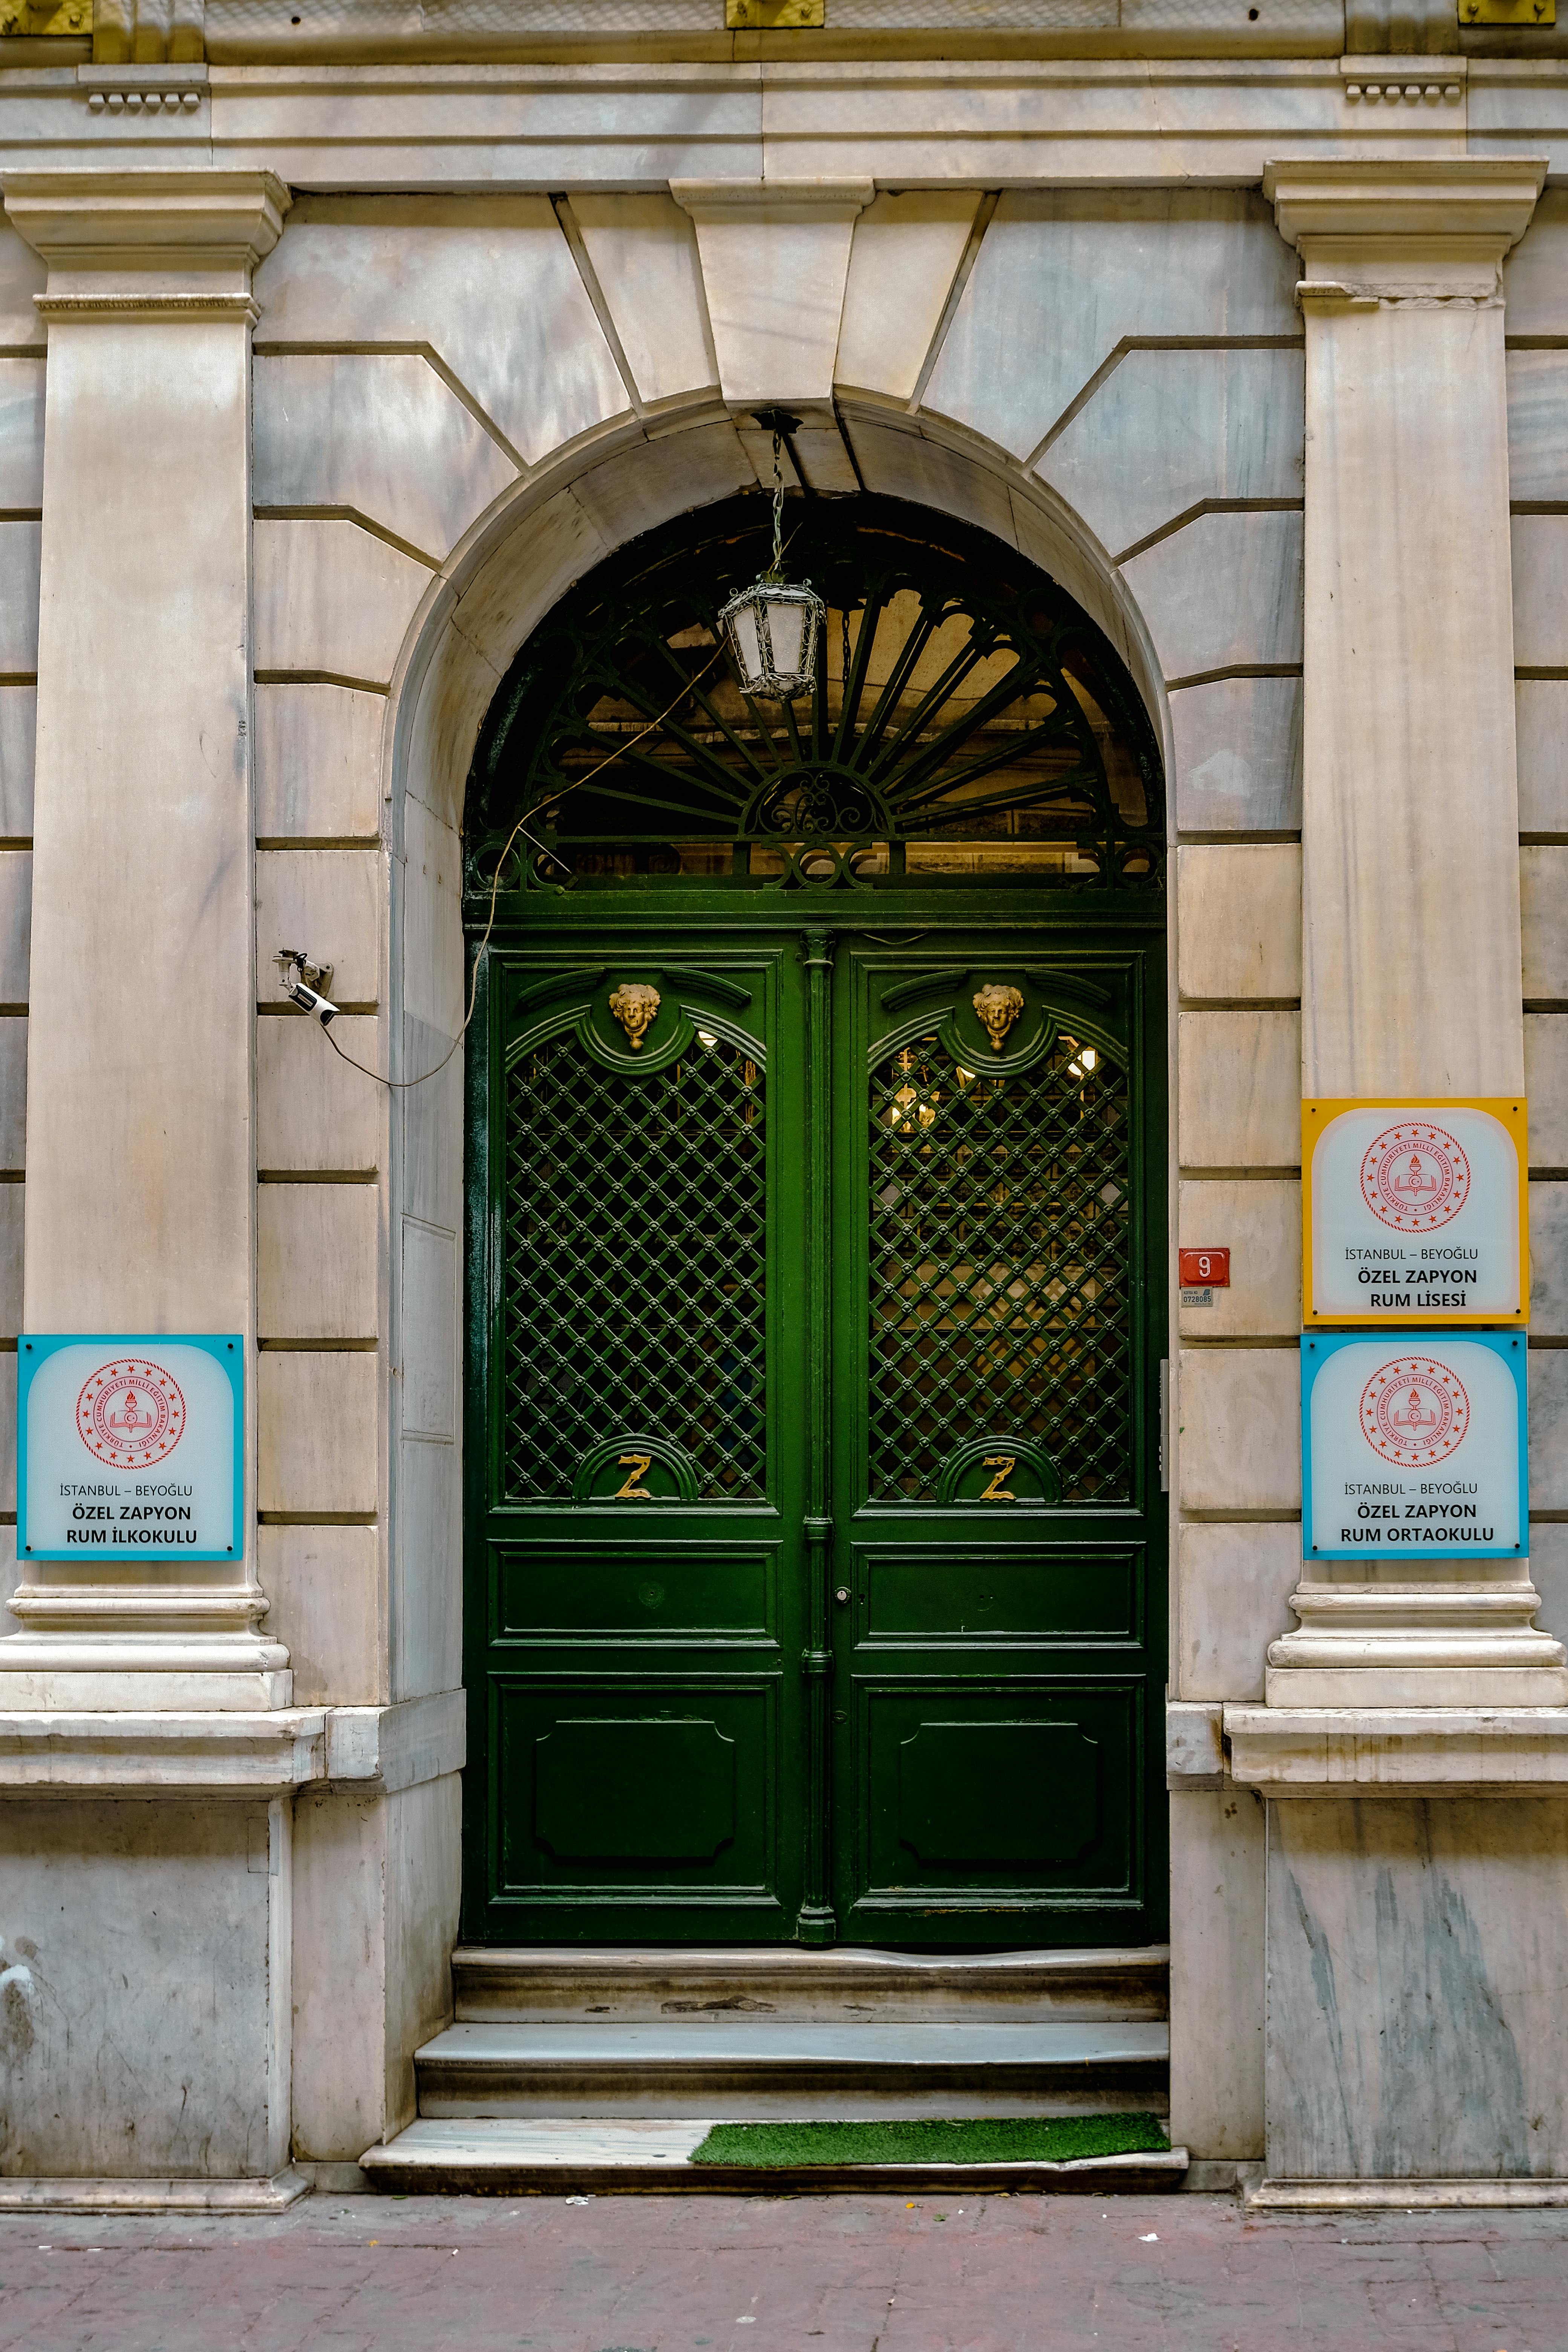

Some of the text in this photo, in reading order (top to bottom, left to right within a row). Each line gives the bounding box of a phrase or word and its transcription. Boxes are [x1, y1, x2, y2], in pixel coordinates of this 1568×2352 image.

[1381, 1142, 1450, 1211] TÜRKİYE CUMHURİYETİ MİLLİ EĞİTİM BAKANLIĞI
[1345, 1247, 1406, 1260] İSTANBUL
[1421, 1246, 1478, 1259] BEYOĞLU
[1199, 1256, 1210, 1277] 9
[1358, 1267, 1477, 1284] ÖZEL ZAPYON
[1371, 1290, 1466, 1307] RUM LİSESİ
[96, 1379, 165, 1447] TÜRKİYE CUMHURİYETİ MİLLİ EĞİTİM BAKANLIĞI
[1380, 1377, 1449, 1446] TÜRKİYE CUMHURİYETİ MİLLİ EĞİTİM BAKANLIĞI
[615, 1454, 652, 1498] Z
[979, 1455, 1017, 1499] Z
[60, 1483, 121, 1496] İSTANBUL
[136, 1483, 192, 1496] BEYOĞLU
[1344, 1482, 1406, 1495] İSTANBUL
[1421, 1481, 1477, 1494] BEYOĞLU
[72, 1503, 191, 1520] ÖZEL ZAPYON
[1357, 1502, 1476, 1519] ÖZEL ZAPYON
[67, 1527, 197, 1544] RUM İLKOKULU
[1341, 1528, 1494, 1542] RUM ORTAOKULU
